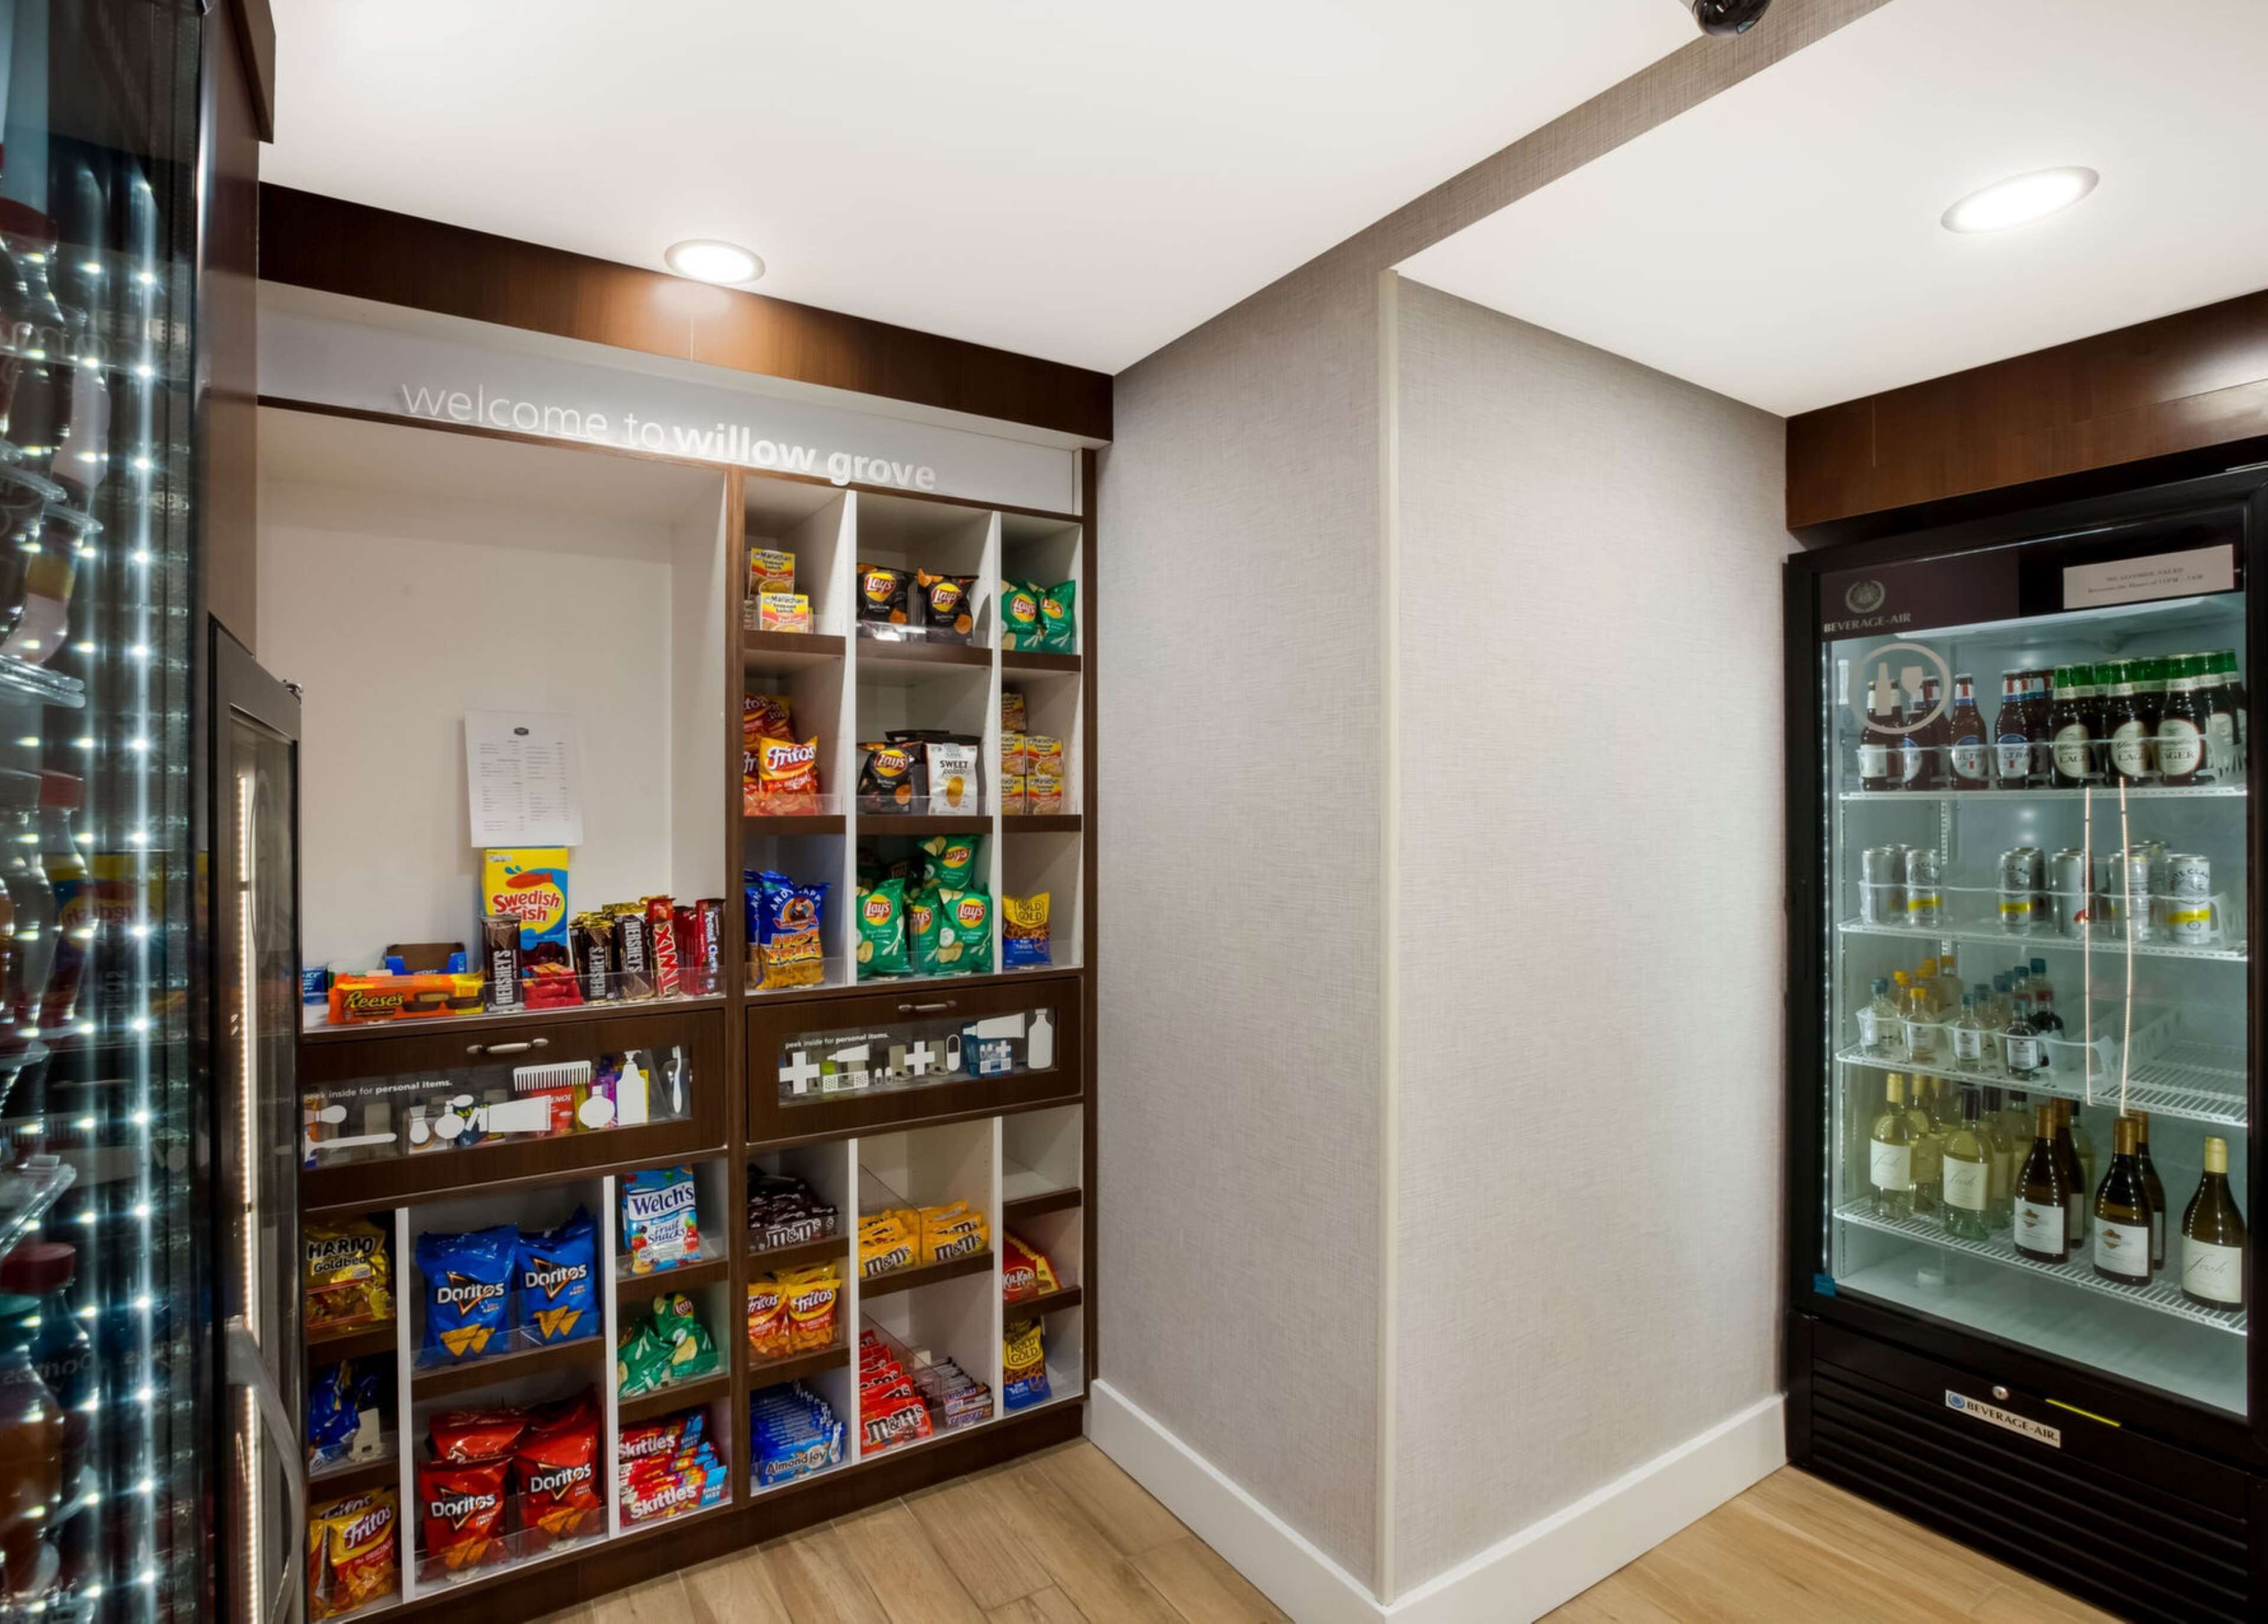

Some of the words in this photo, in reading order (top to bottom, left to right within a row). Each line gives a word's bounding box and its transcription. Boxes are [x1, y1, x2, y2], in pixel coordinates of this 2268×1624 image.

[401, 383, 608, 440] welcome
[623, 412, 665, 450] to
[672, 423, 817, 472] willow
[826, 449, 936, 490] grove
[1824, 613, 1911, 633] BEVERAGE-AIR
[766, 746, 815, 770] Fritos
[939, 760, 968, 769] SWEET
[492, 889, 561, 913] Swedish
[1018, 912, 1043, 922] GOLD
[654, 926, 680, 1000] TWIX
[344, 991, 404, 1008] Reese's
[803, 1039, 823, 1047] inside
[836, 1034, 867, 1044] personal
[329, 1089, 357, 1098] inside
[359, 1086, 373, 1095] for
[376, 1081, 419, 1095] personal
[422, 1079, 453, 1088] items.
[632, 1185, 694, 1216] Welch's
[648, 1228, 685, 1245] Snacks
[655, 1220, 679, 1234] Fruit
[525, 1264, 587, 1288] Doritos
[437, 1283, 505, 1304] Doritos
[792, 1289, 833, 1312] Fritos
[1011, 1347, 1038, 1363] GOLD
[1967, 1401, 2058, 1441] BEVERAGE-AIR
[619, 1435, 676, 1460] Skittles
[531, 1463, 591, 1492] Doritos
[431, 1493, 496, 1518] Doritos
[631, 1486, 697, 1519] Skittles
[343, 1505, 392, 1549] Fritos
